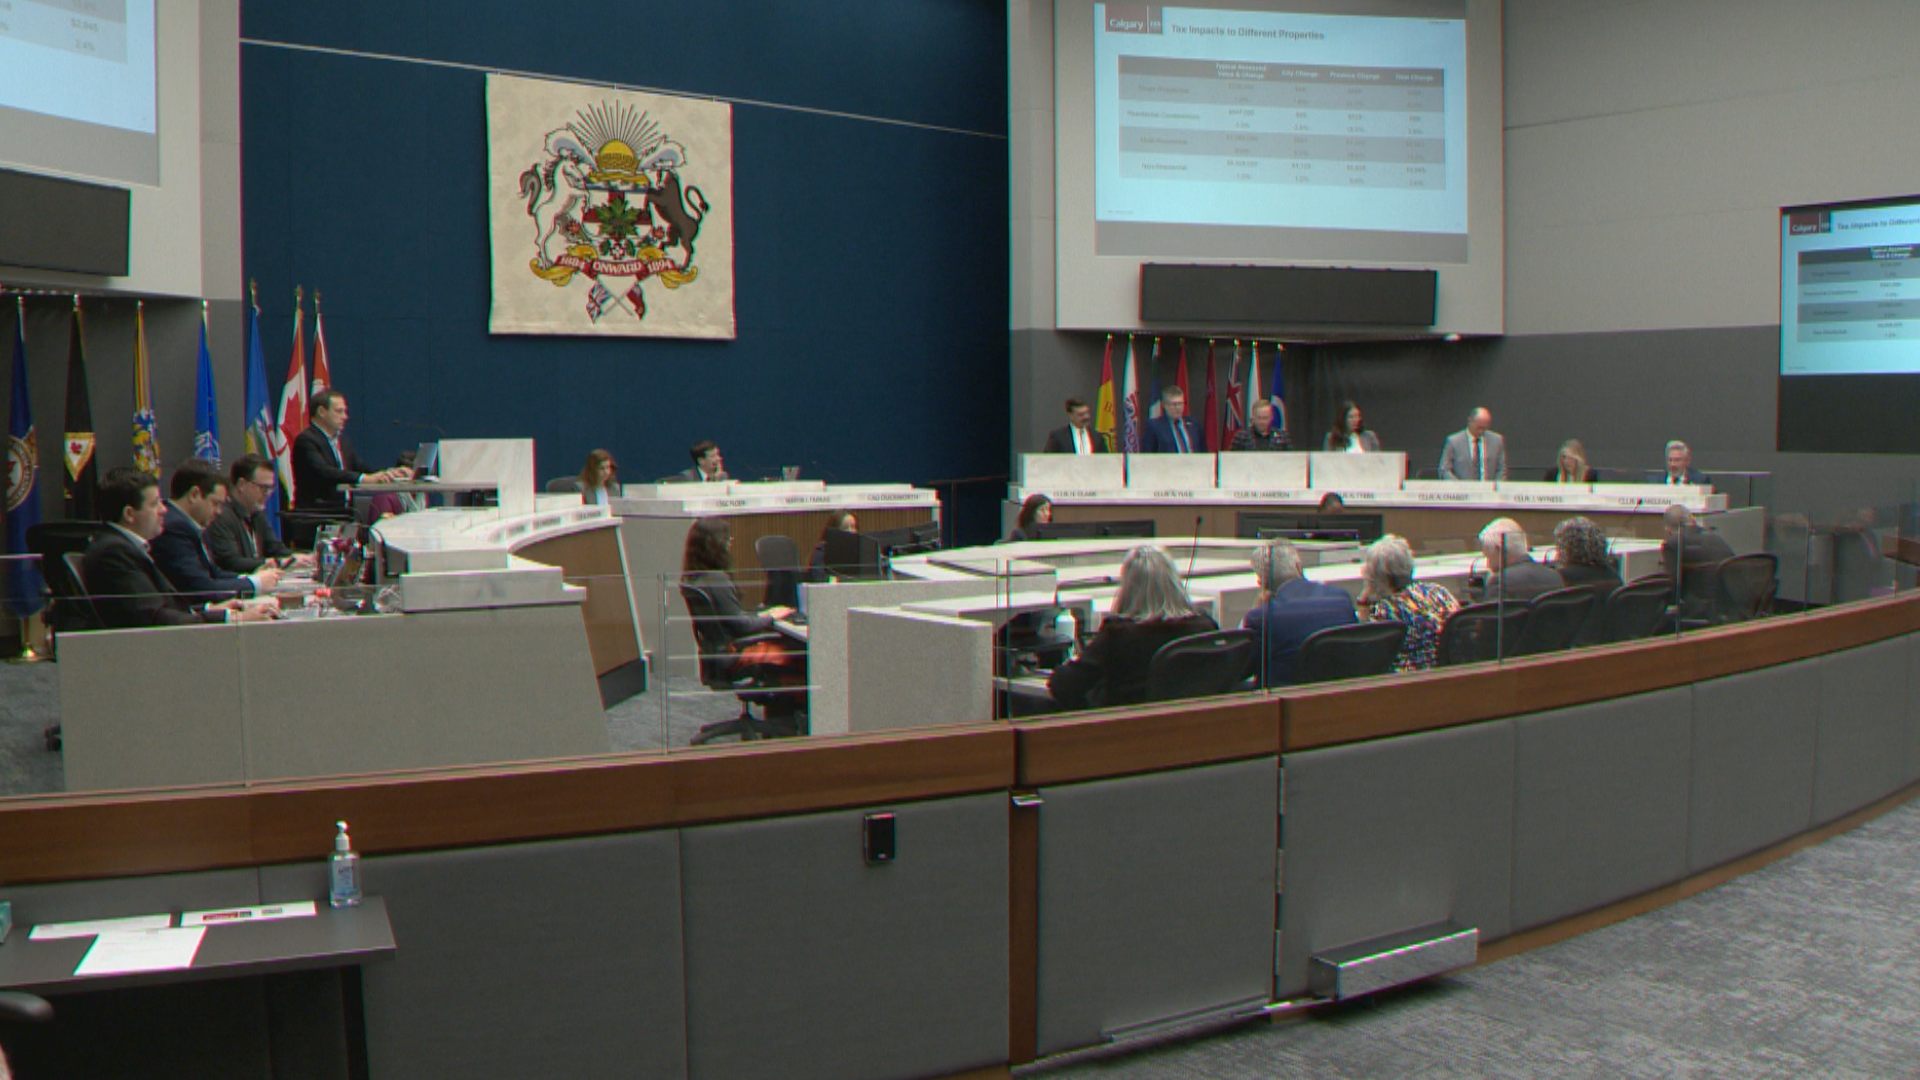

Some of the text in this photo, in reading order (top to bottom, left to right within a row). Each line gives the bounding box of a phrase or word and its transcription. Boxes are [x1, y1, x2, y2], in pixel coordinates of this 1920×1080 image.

[1109, 18, 1144, 31] Calgary
[1172, 24, 1325, 41] Tax Impacts to Different Properties
[593, 260, 642, 274] ONWARD
[647, 259, 673, 273] 1894
